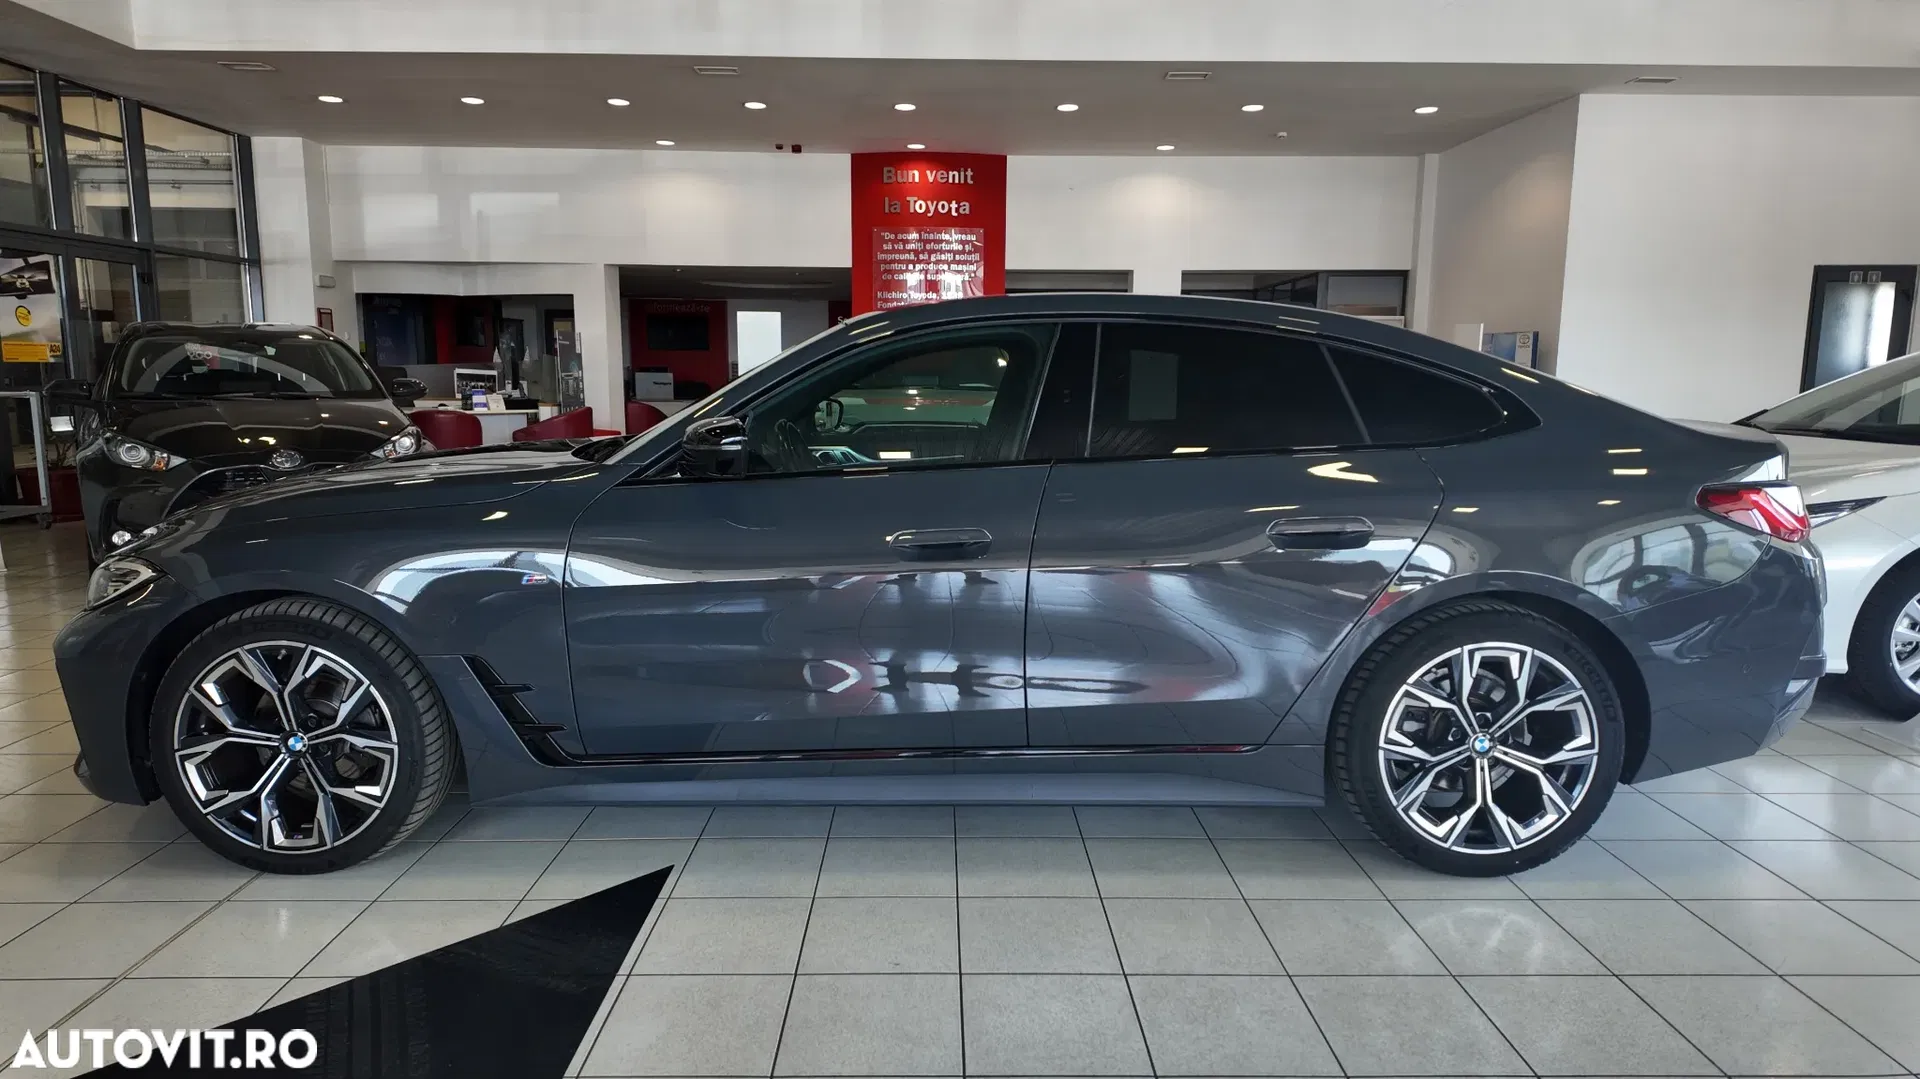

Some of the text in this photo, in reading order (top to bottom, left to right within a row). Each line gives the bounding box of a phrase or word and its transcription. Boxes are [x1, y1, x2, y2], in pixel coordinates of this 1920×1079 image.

[883, 166, 974, 184] Bun venit
[884, 196, 970, 217] la Toyota
[897, 232, 919, 240] acum
[954, 233, 976, 241] vreau
[883, 242, 892, 250] să
[894, 242, 903, 250] vă
[925, 242, 963, 250] eforturile
[919, 252, 929, 260] să
[880, 263, 906, 271] pentru
[915, 262, 949, 271] produce
[882, 272, 892, 280] de
[877, 291, 907, 299] Kiichiro
